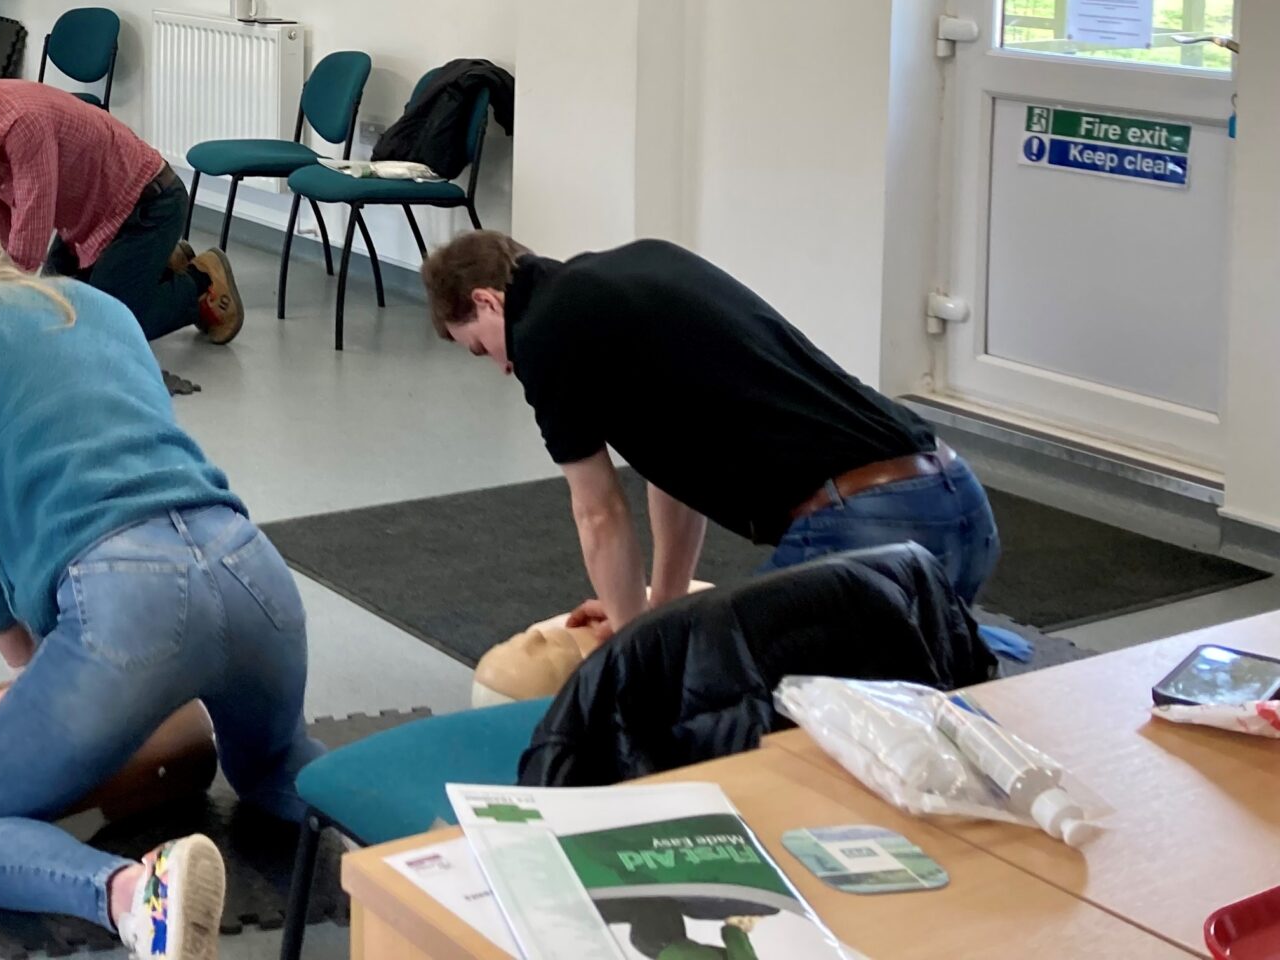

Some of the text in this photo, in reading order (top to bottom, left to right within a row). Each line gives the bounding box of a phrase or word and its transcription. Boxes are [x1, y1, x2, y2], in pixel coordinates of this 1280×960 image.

[1080, 116, 1168, 147] Fire exit
[1068, 143, 1118, 171] Keep
[652, 834, 746, 849] Made Easy
